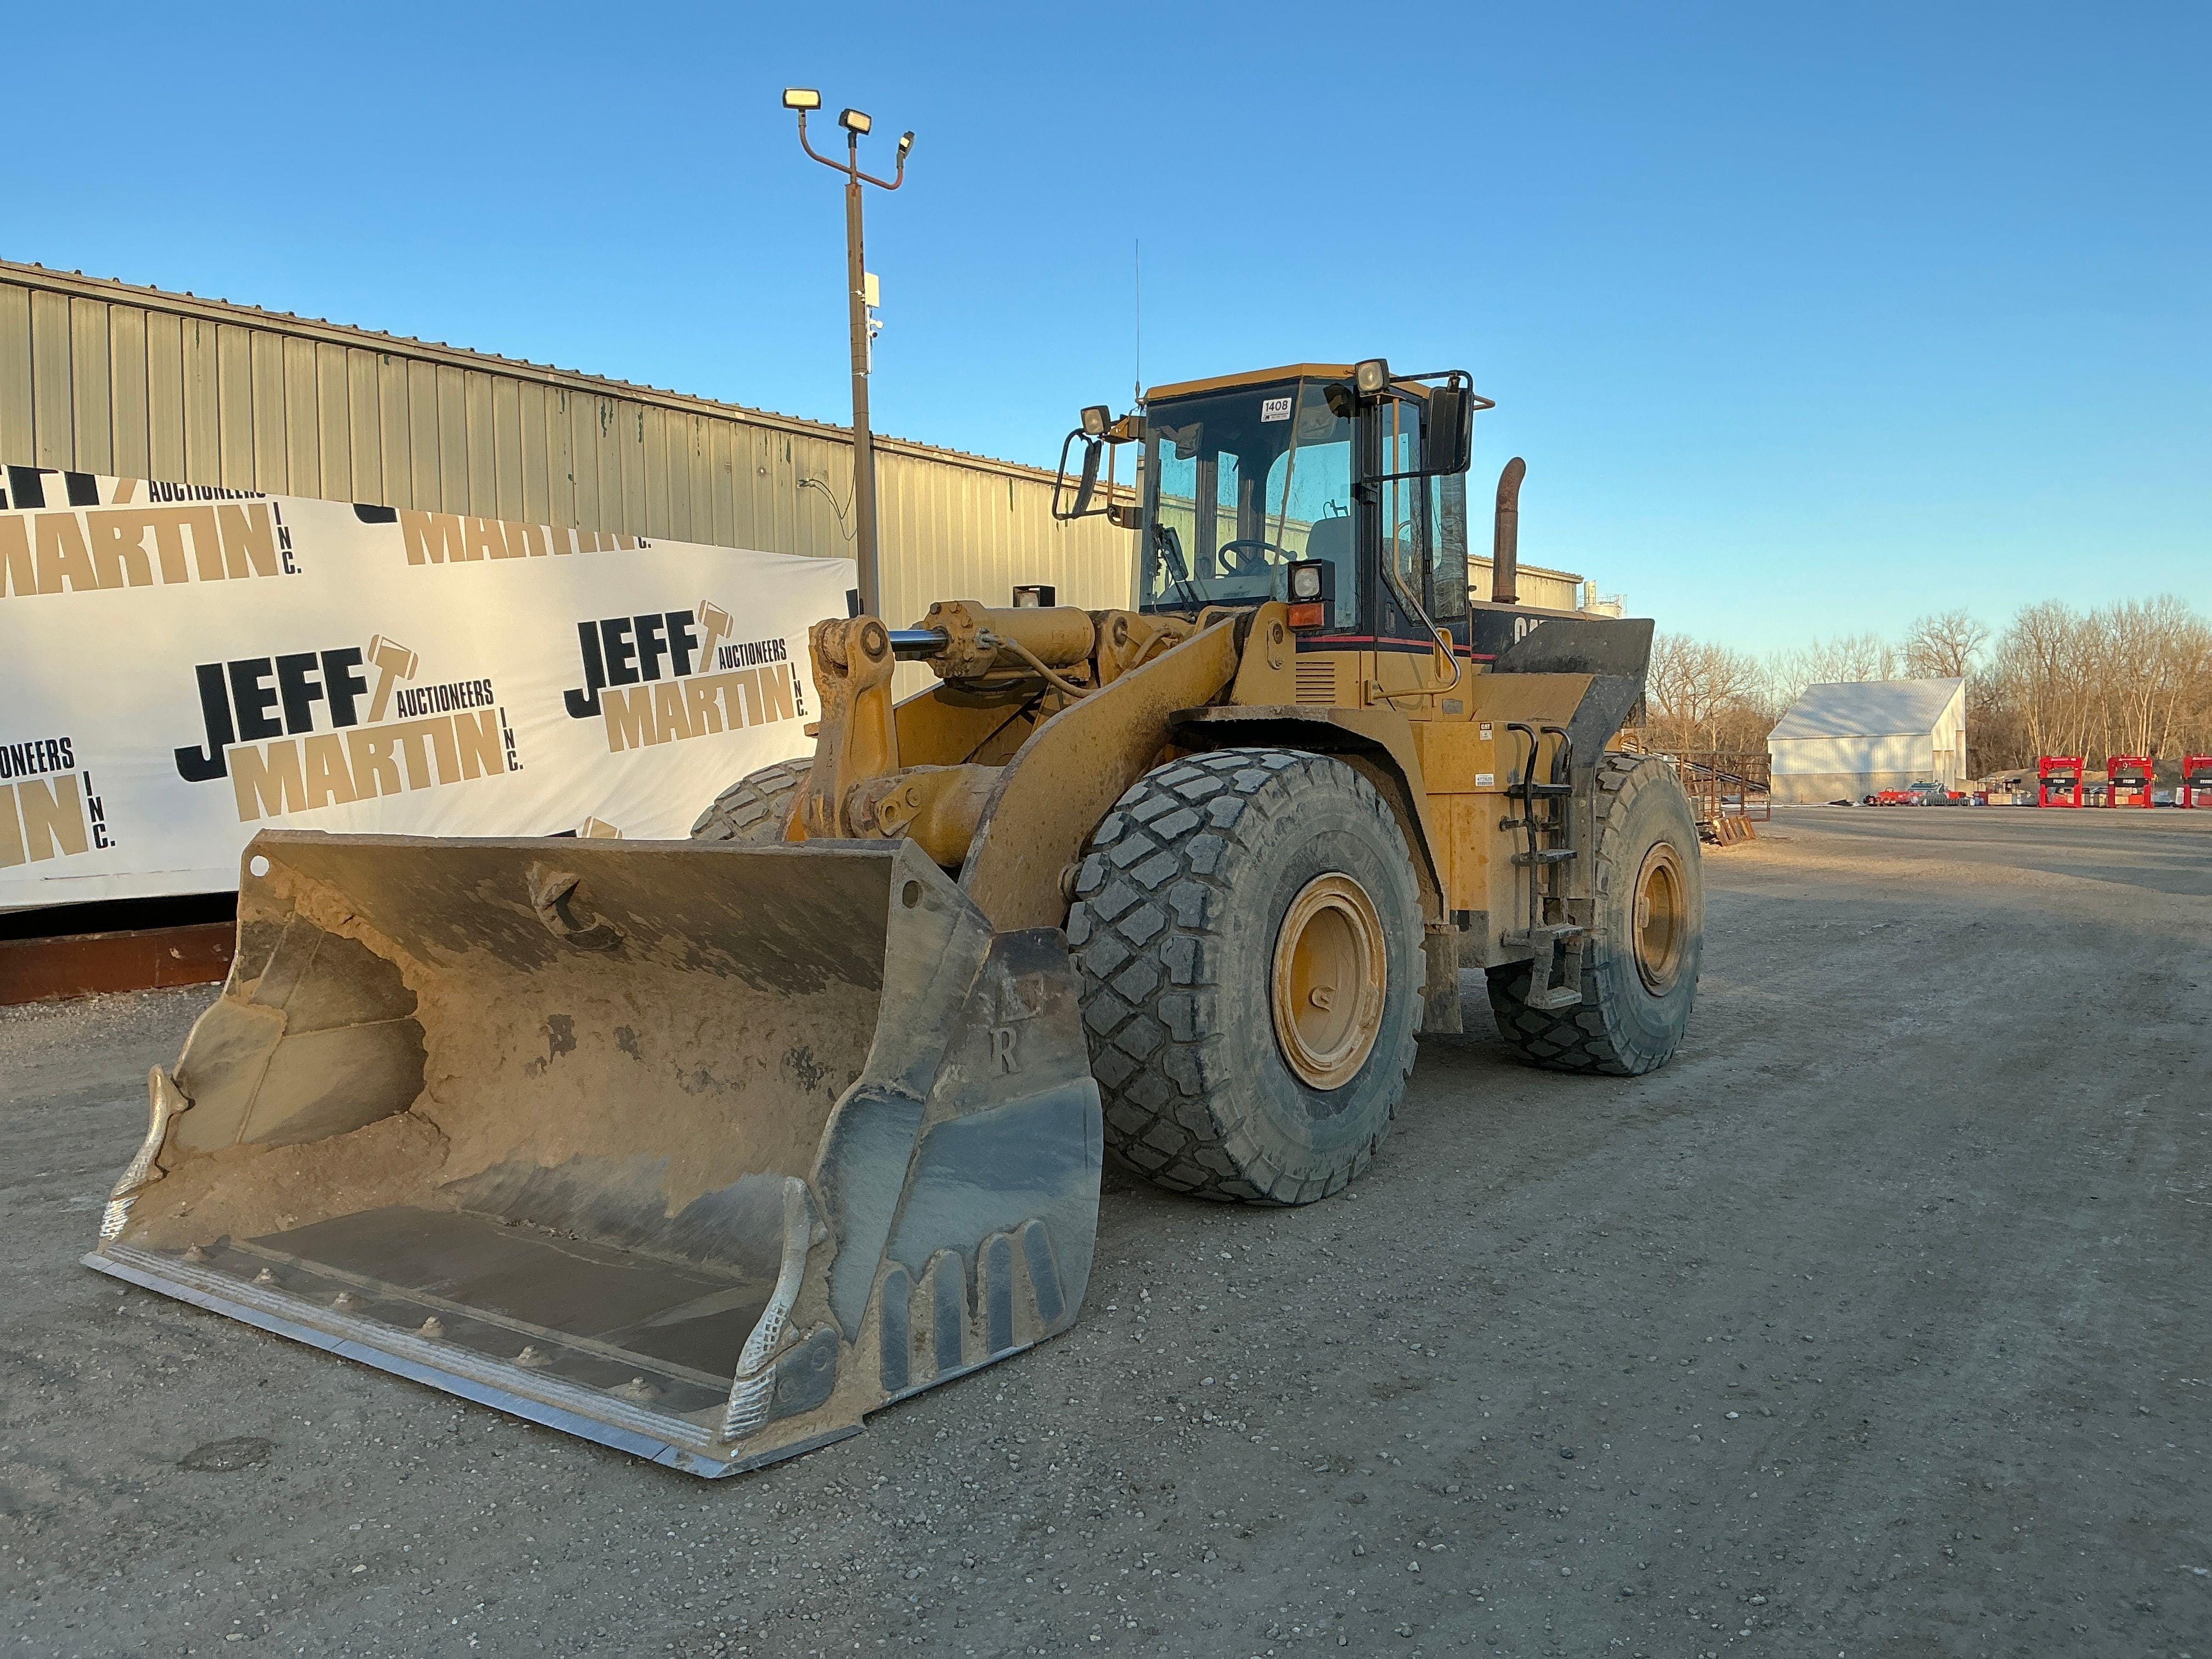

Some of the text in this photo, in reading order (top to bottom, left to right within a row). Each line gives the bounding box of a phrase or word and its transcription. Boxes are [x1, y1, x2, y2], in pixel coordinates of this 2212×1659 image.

[1265, 400, 1288, 413] 1408
[563, 610, 698, 719] JEFF
[718, 638, 787, 670] AUCTIONEERS
[791, 662, 808, 716] INC.
[173, 646, 369, 782] JEFF
[396, 678, 494, 719] AUCTIONEERS
[601, 664, 795, 753] MARTIN
[227, 708, 506, 822] MARTIN
[499, 707, 524, 771] INC.
[82, 770, 116, 849] INC.
